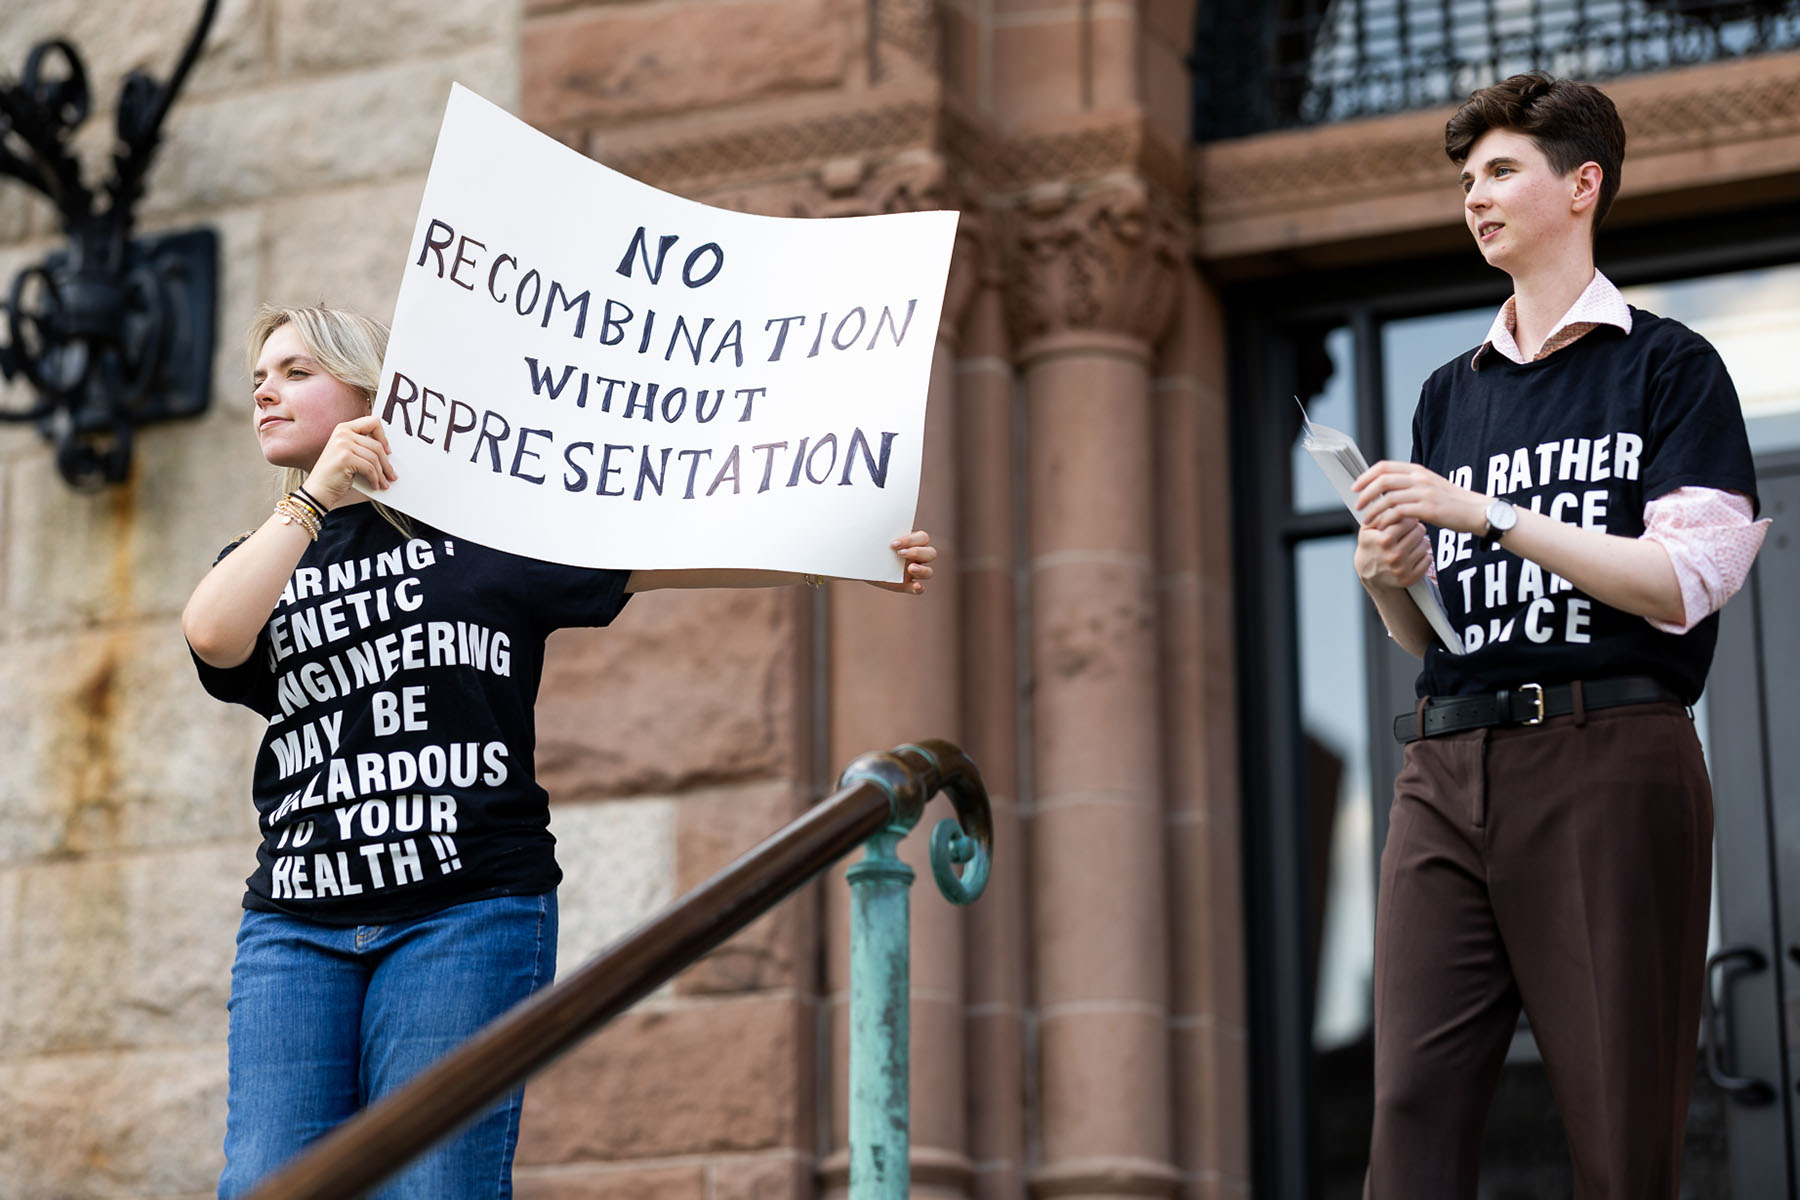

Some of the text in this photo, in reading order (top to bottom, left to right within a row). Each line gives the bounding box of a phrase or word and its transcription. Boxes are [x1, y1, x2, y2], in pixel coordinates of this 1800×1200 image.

[416, 218, 918, 368] RECOMBINATION
[616, 226, 724, 289] NO
[524, 356, 767, 424] WITHOUT
[381, 371, 899, 501] REPRESENTATION
[1486, 432, 1644, 498] RATHER
[1436, 528, 1473, 571] BE
[268, 577, 424, 674] ENETIC
[269, 620, 511, 727] NGINEERING
[269, 685, 429, 780] MAY BE
[334, 794, 458, 842] YOUR
